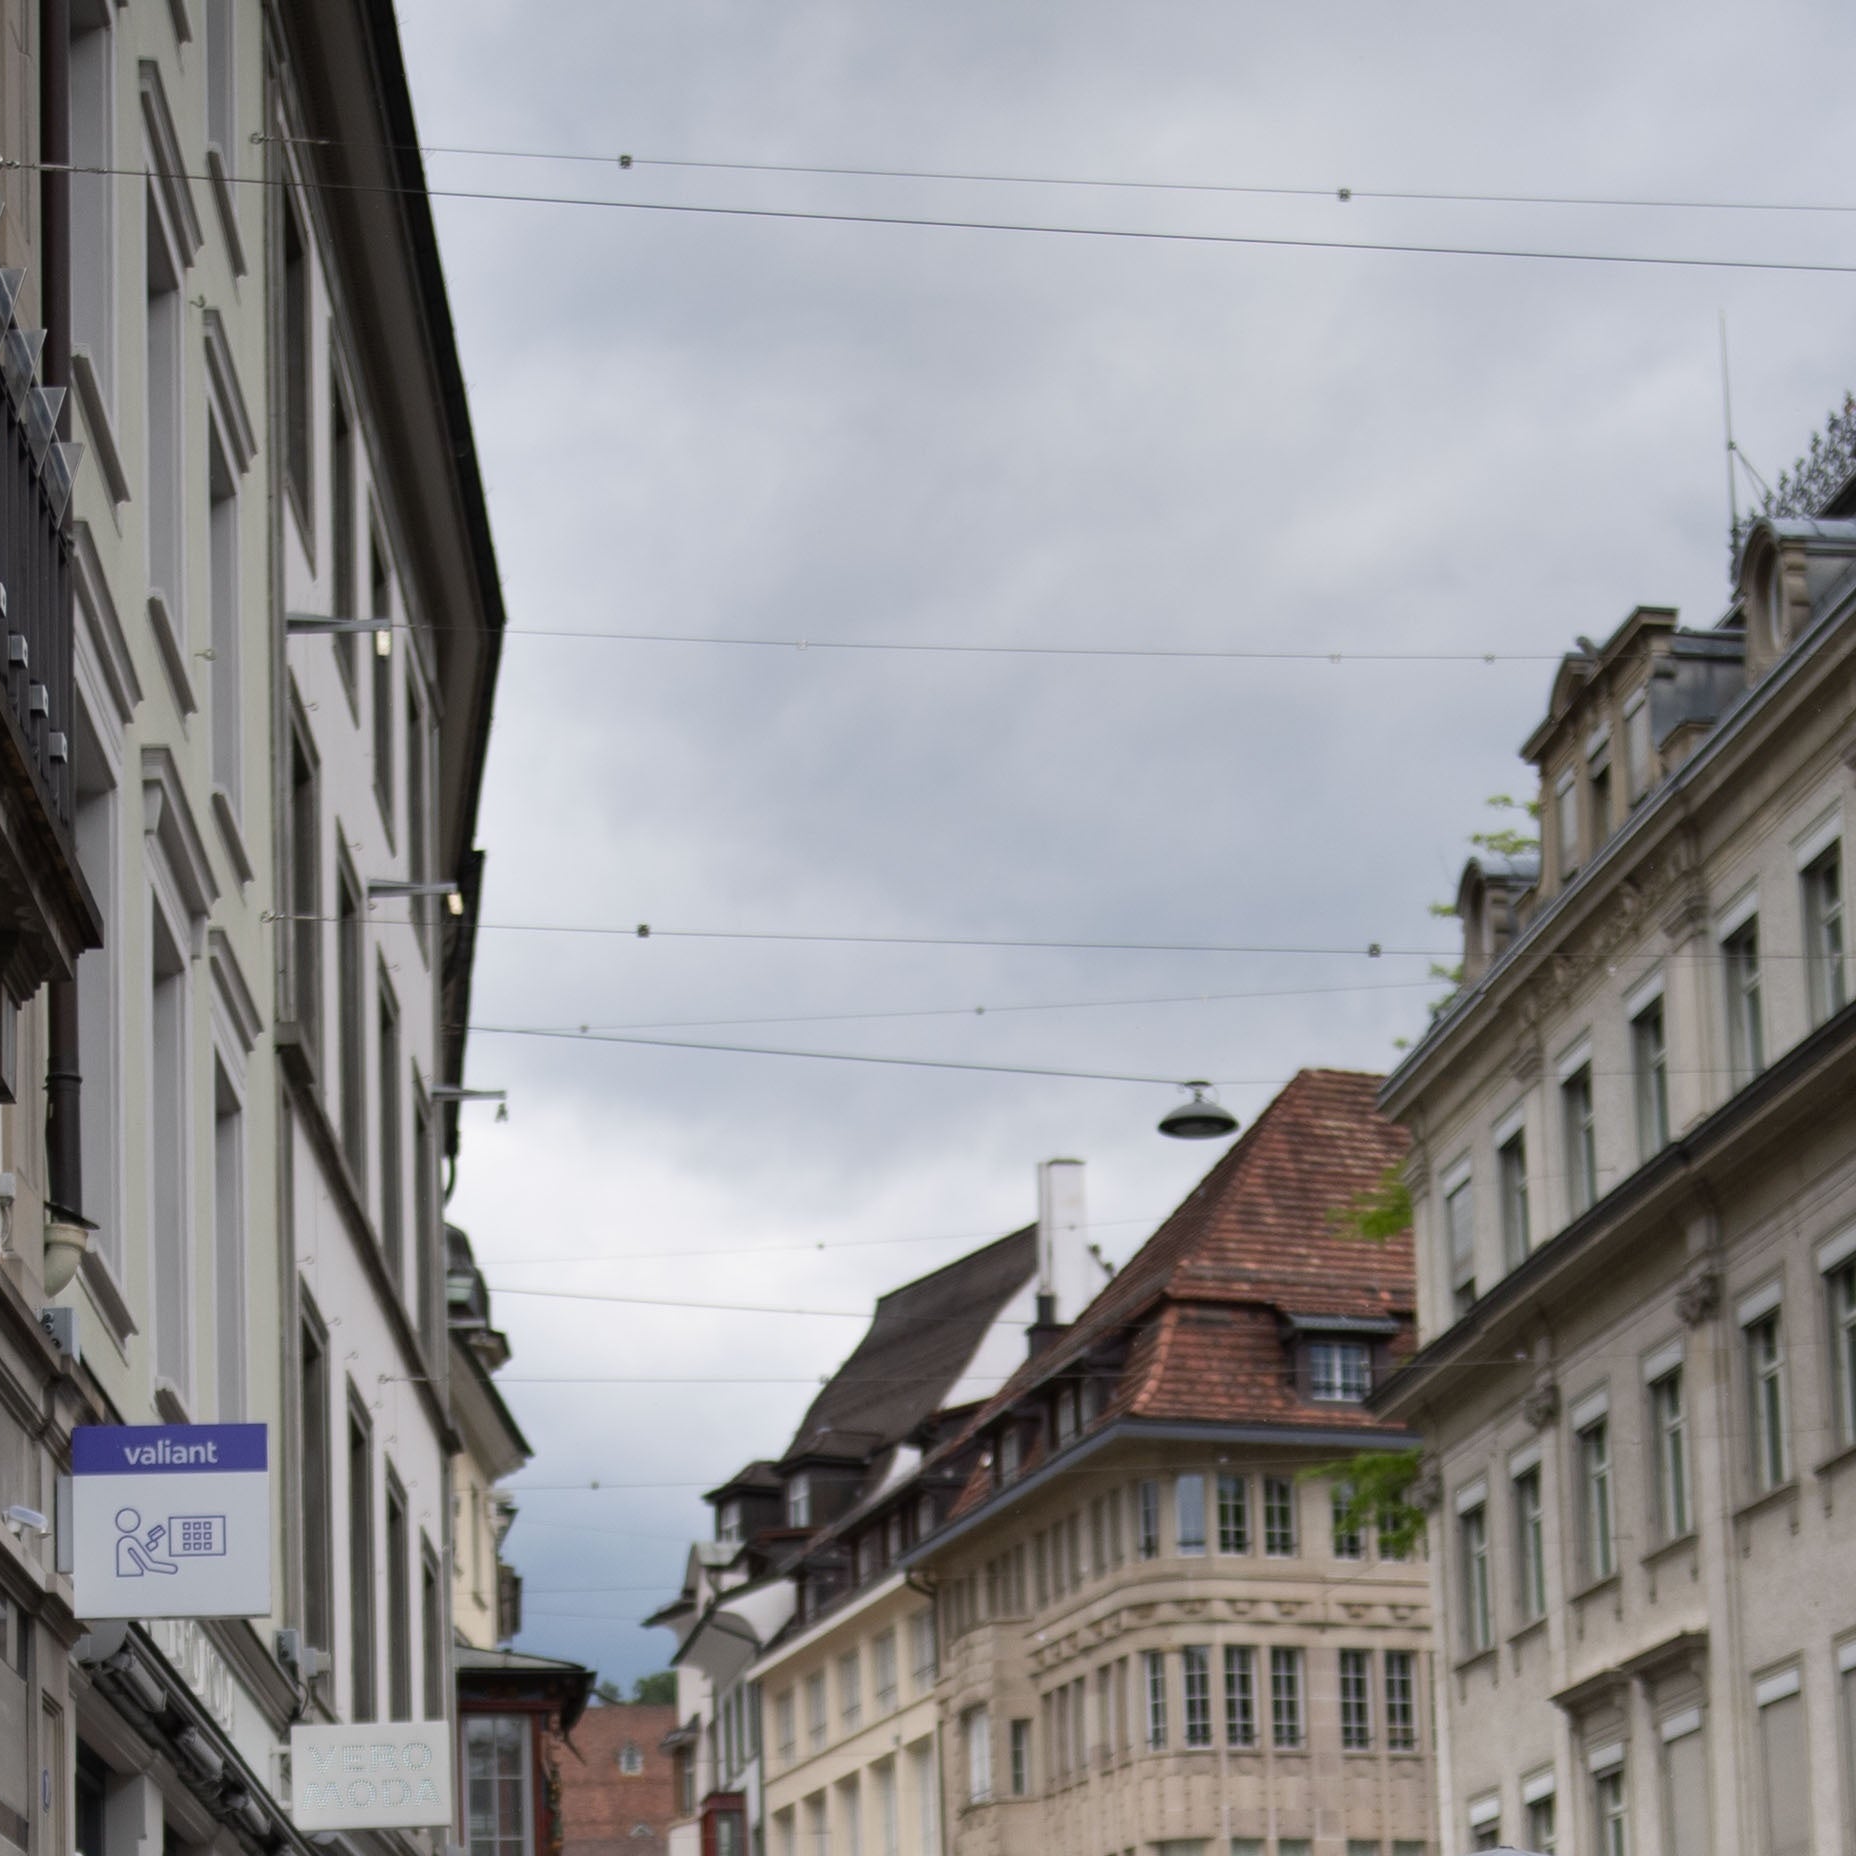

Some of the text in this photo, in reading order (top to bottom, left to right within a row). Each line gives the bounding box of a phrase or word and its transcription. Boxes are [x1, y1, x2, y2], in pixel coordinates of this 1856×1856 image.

[124, 1438, 218, 1468] valiant
[307, 1742, 432, 1774] VERO
[302, 1778, 441, 1809] MODA
